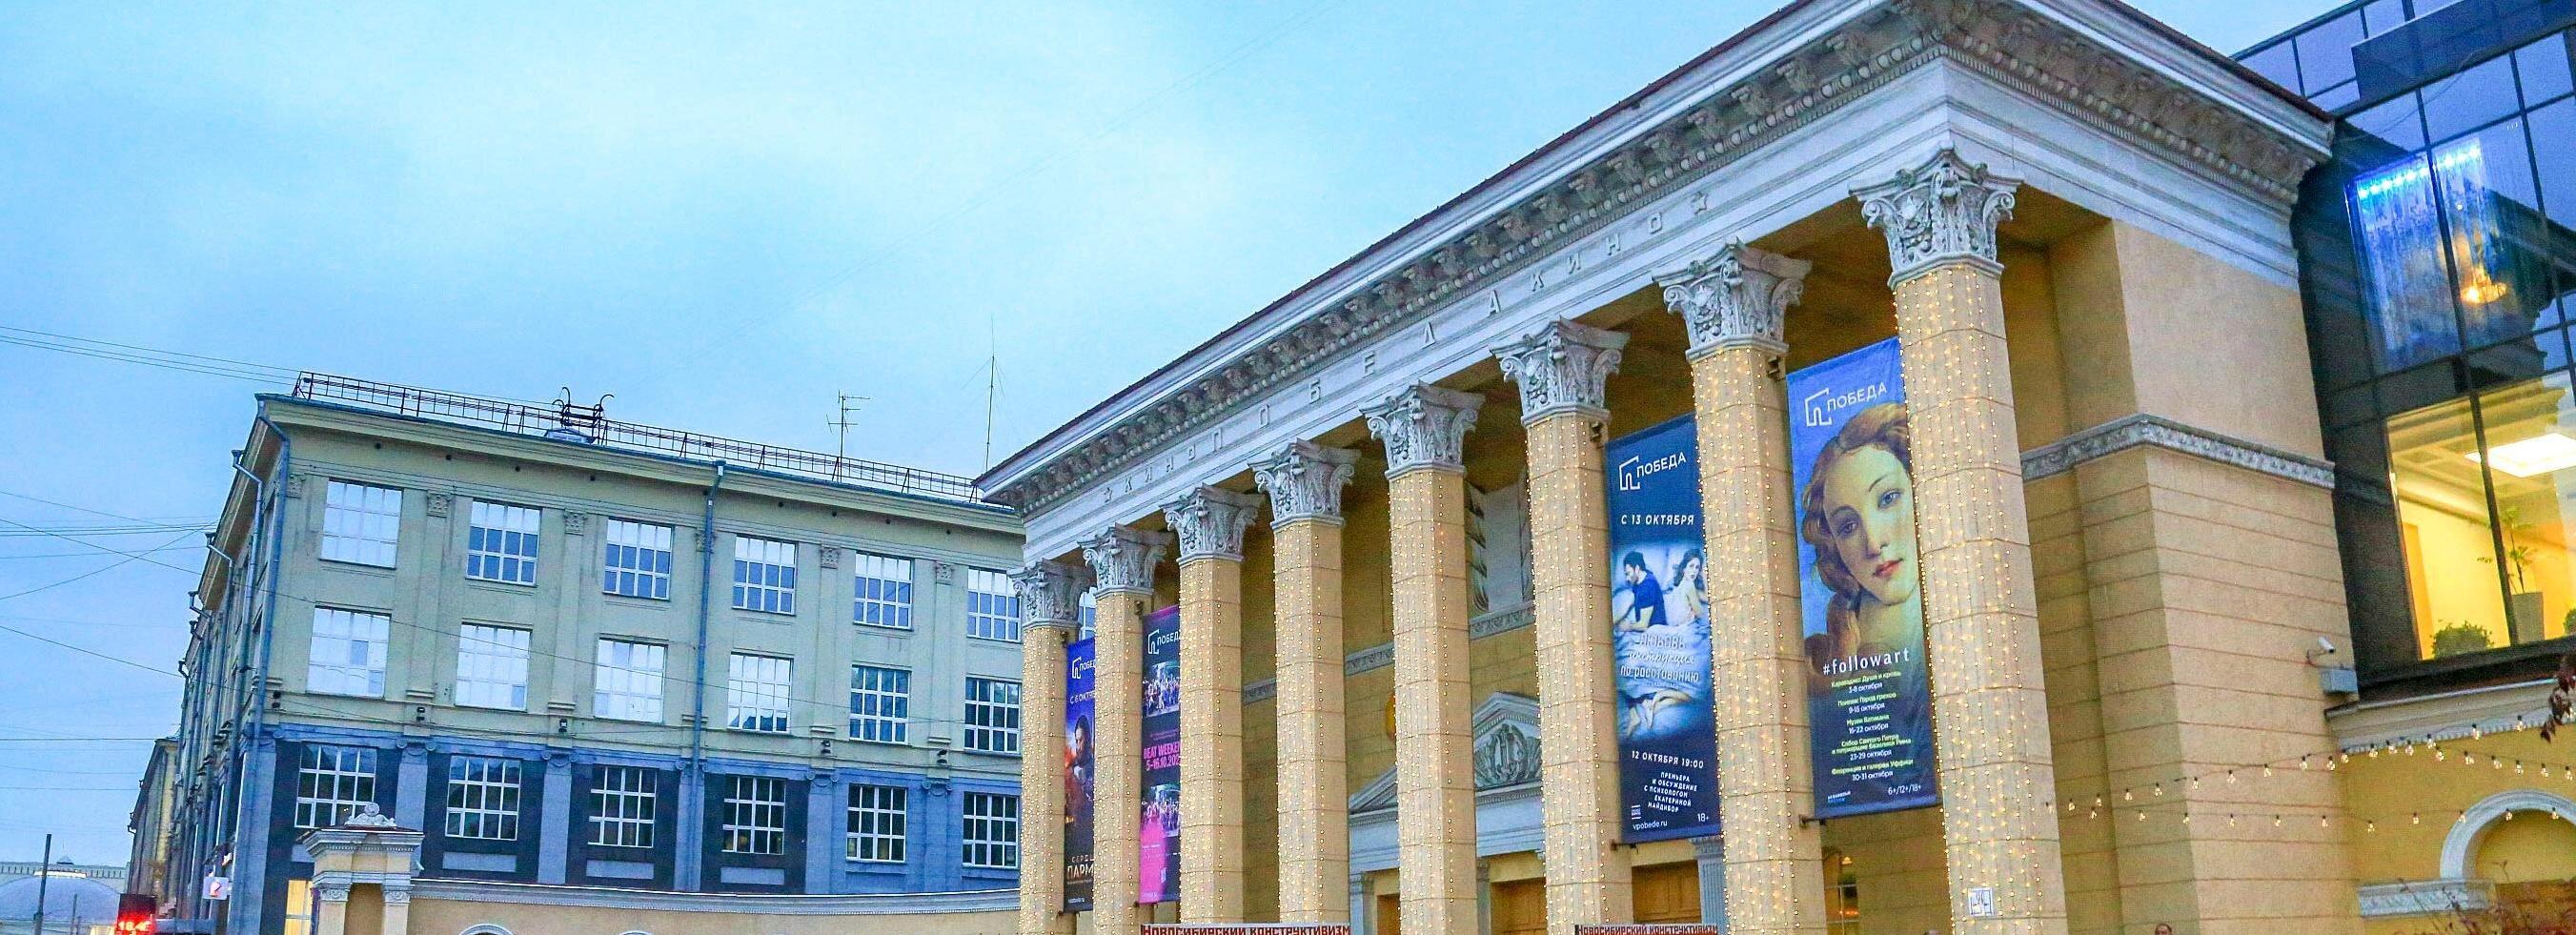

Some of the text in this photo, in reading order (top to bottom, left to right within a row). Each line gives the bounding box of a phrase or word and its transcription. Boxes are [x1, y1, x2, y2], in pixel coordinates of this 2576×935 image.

[1211, 289, 1502, 453] ПОБЕДА
[1530, 211, 1663, 293] КИНО
[1827, 382, 1887, 413] ПОБЕДА
[1636, 452, 1687, 478] ПОБЕДА
[1621, 515, 1694, 525] С 13 ОКТЯБРЯ
[1157, 631, 1180, 645] ПОБЕД
[1079, 659, 1095, 672] ПОБЕ
[1822, 647, 1910, 676] #followart
[1642, 752, 1678, 764] ОКТЯБРЯ
[1682, 758, 1704, 768] 19:00
[1660, 771, 1690, 782] ПРЕМЬЕРА
[1650, 785, 1688, 798] ПСИХОЛОГОМ
[1697, 813, 1709, 823] 18+
[1067, 863, 1094, 880] ПАРМ
